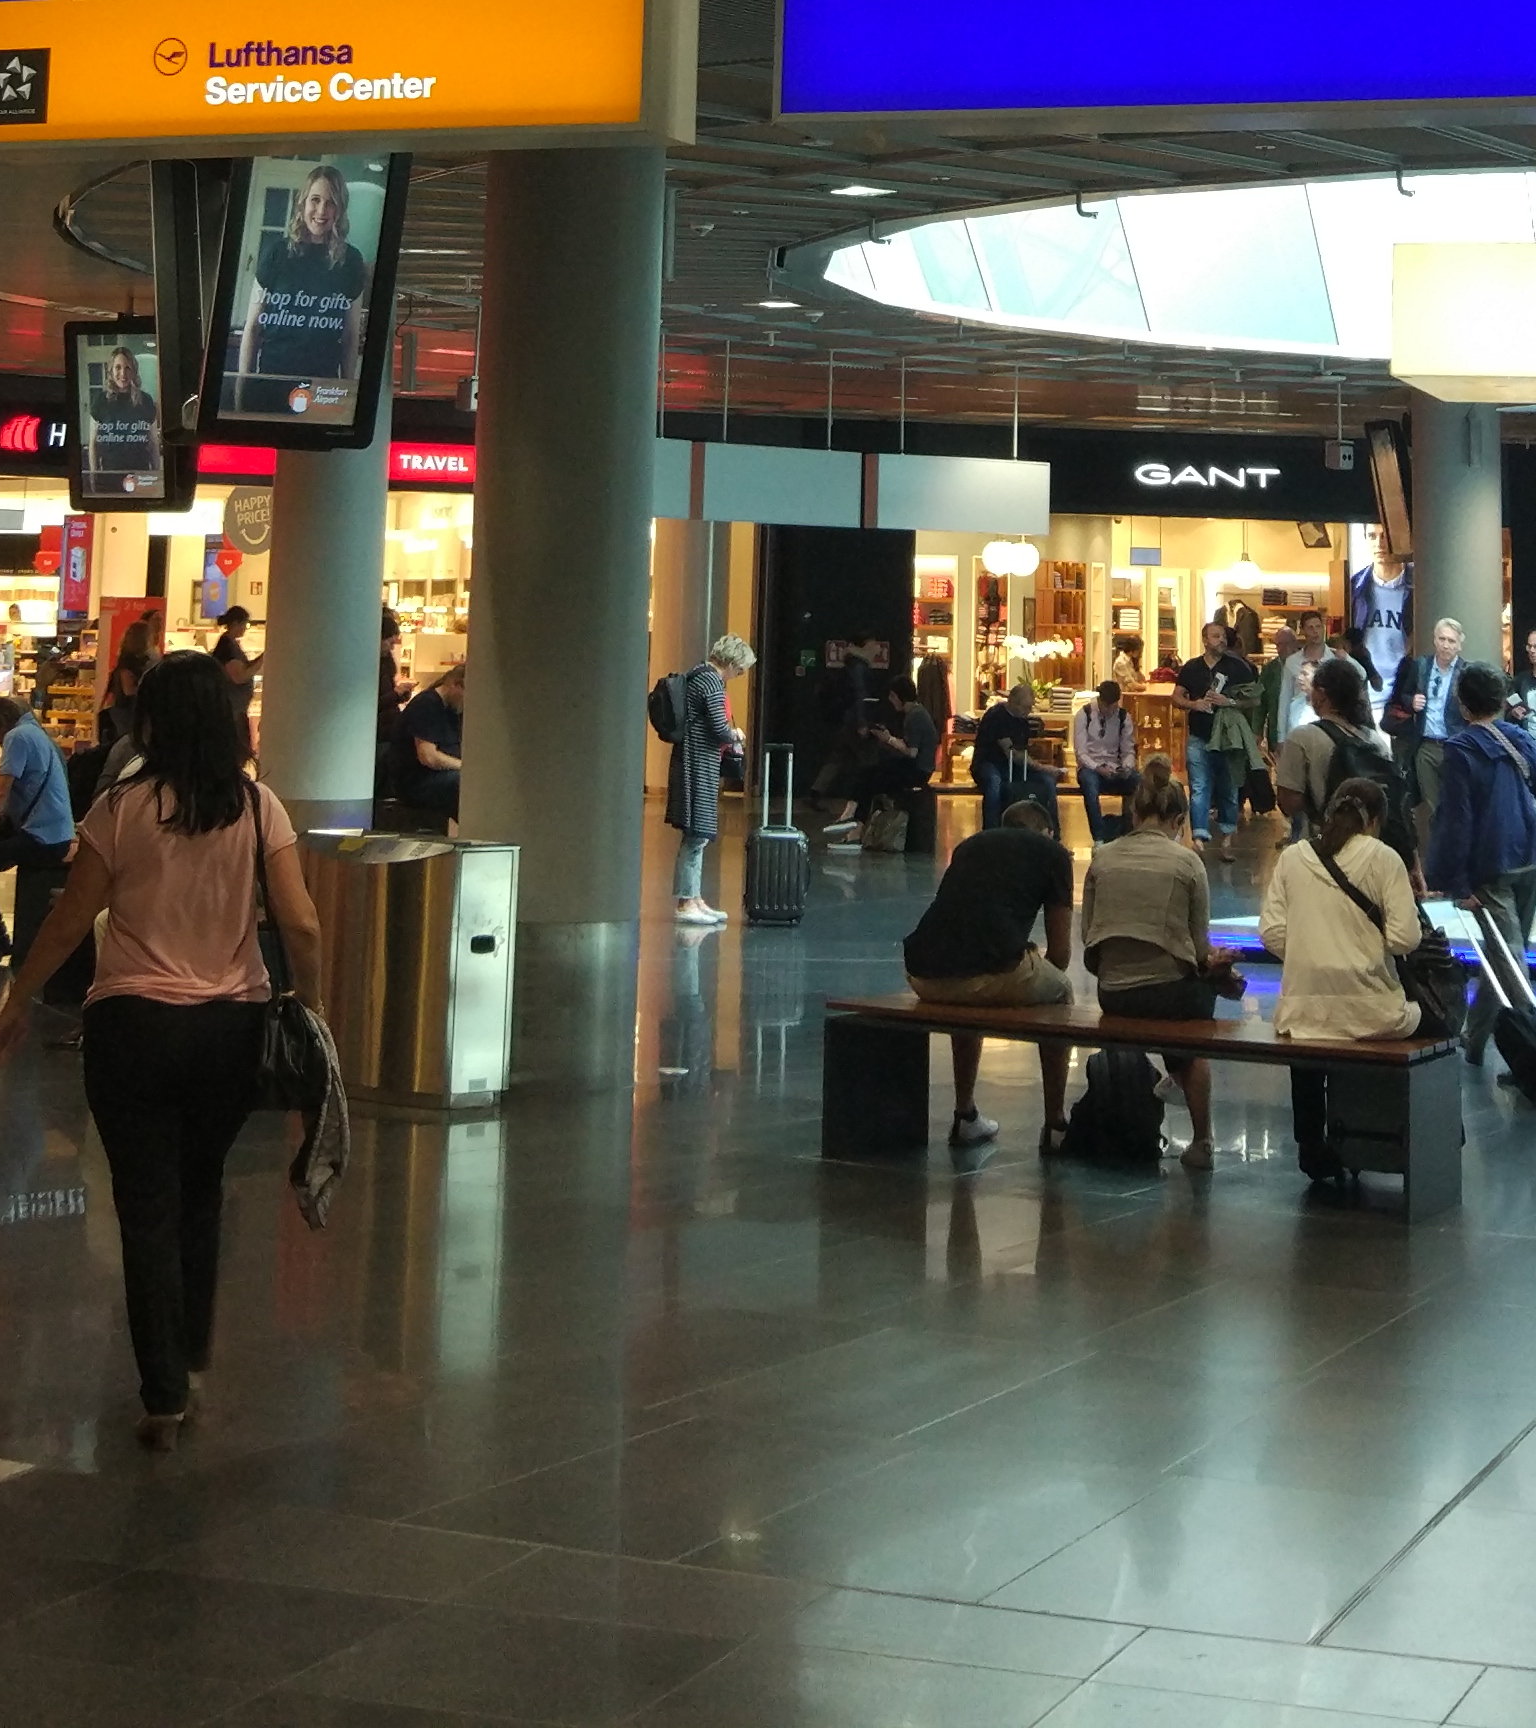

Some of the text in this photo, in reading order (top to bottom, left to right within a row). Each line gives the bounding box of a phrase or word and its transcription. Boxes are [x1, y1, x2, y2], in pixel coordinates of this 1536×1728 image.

[207, 39, 354, 70] Lufthansa
[204, 72, 436, 107] Service Center
[294, 290, 316, 308] for
[320, 292, 353, 314] gifts
[258, 311, 345, 331] online now.
[95, 420, 115, 434] hop
[399, 453, 469, 472] TRAVEL
[1134, 462, 1282, 489] GANT
[234, 494, 272, 514] HAPPY
